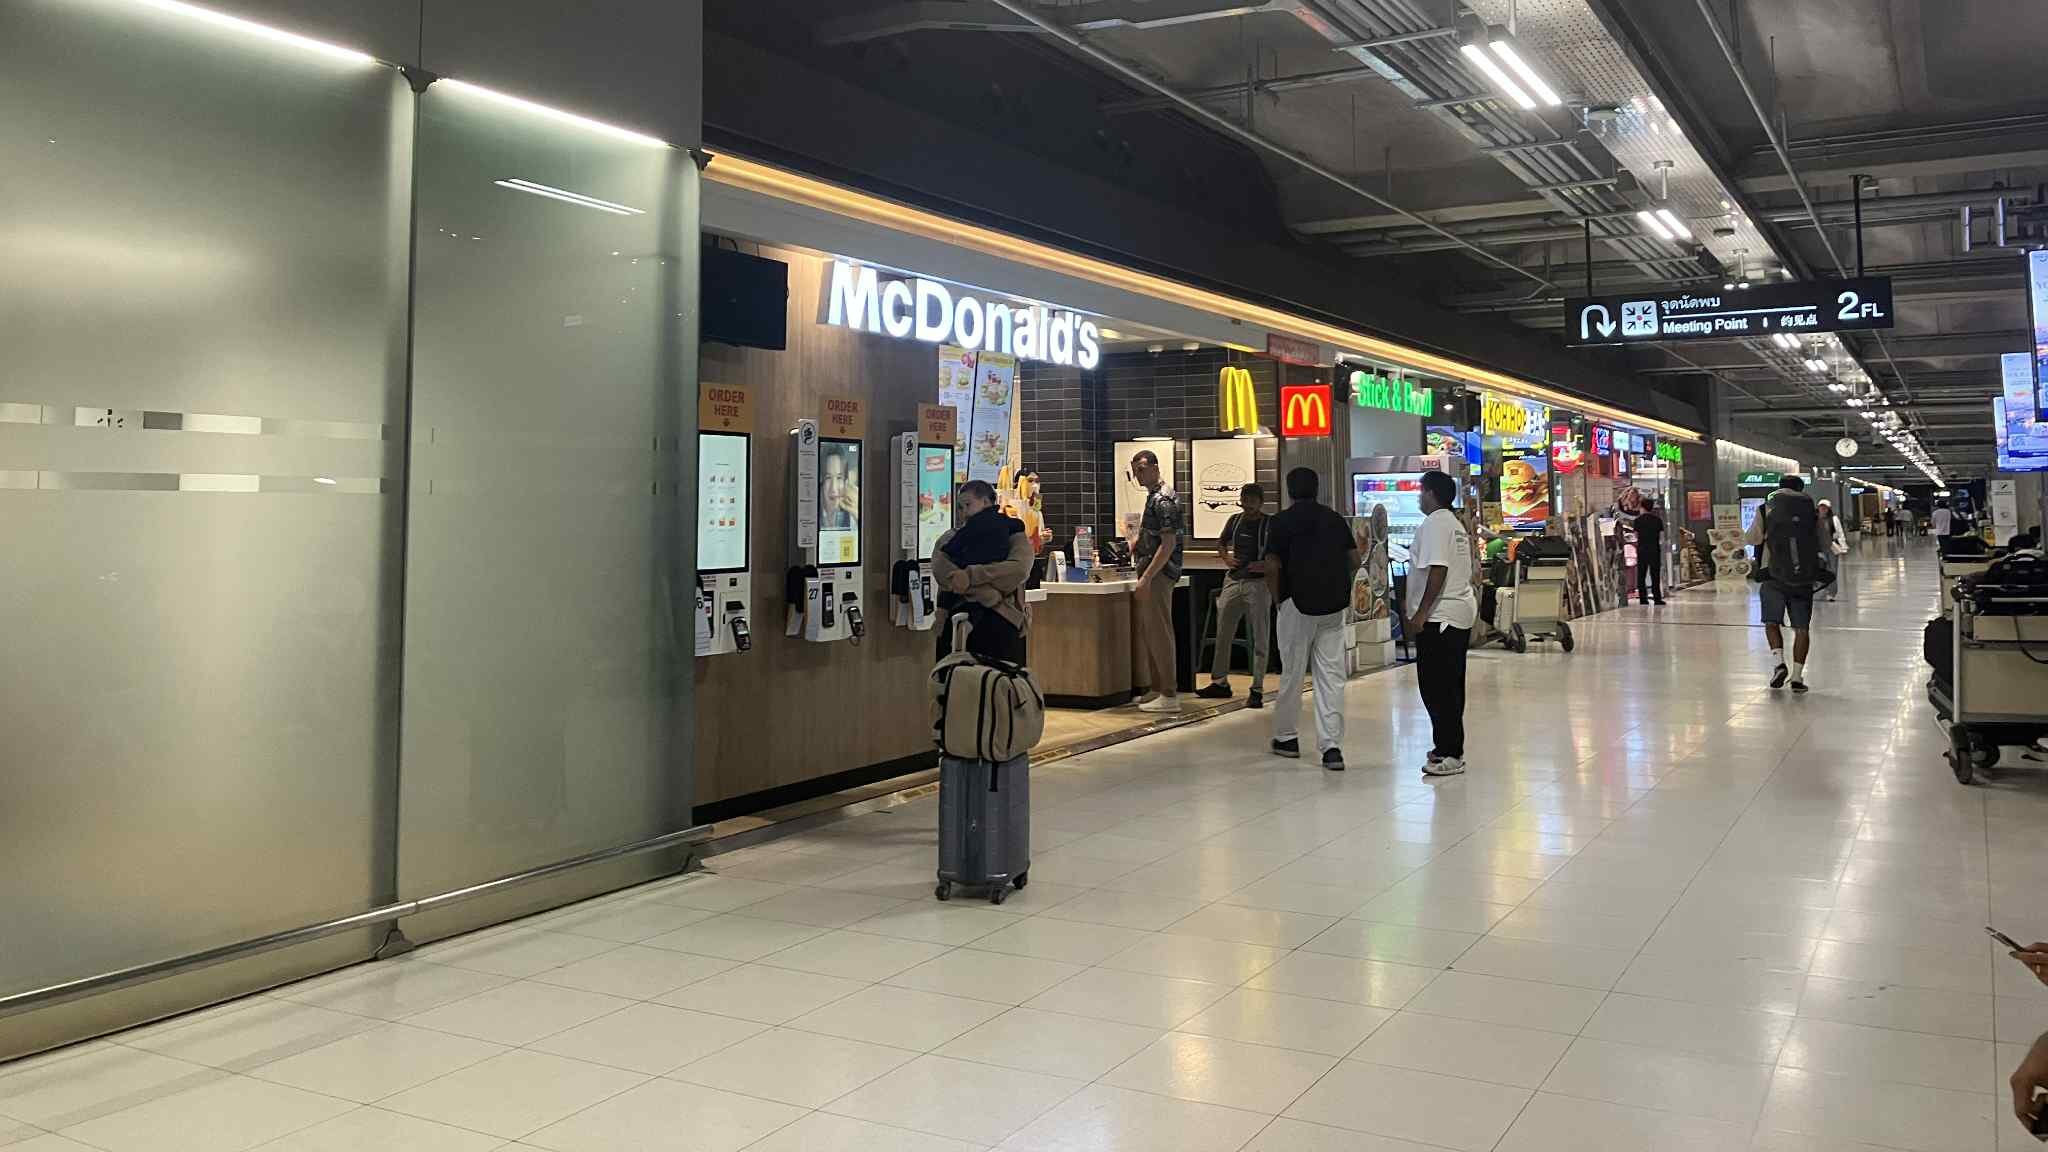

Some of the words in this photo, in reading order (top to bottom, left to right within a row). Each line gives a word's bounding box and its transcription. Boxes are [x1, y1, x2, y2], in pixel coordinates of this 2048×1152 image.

[1660, 295, 1721, 314] จุดนัดพบ
[828, 258, 1100, 370] McDonald's
[1662, 320, 1713, 334] Meeting
[1714, 317, 1749, 331] Point
[708, 388, 745, 403] ORDER
[1358, 373, 1390, 408] Stick
[1392, 378, 1402, 412] &
[713, 404, 739, 418] HERE
[827, 400, 858, 414] ORDER
[832, 413, 854, 426] HERE
[925, 408, 951, 421] ORDER
[928, 420, 948, 433] HERE
[1744, 474, 1763, 482] ATM
[808, 588, 819, 600] 27
